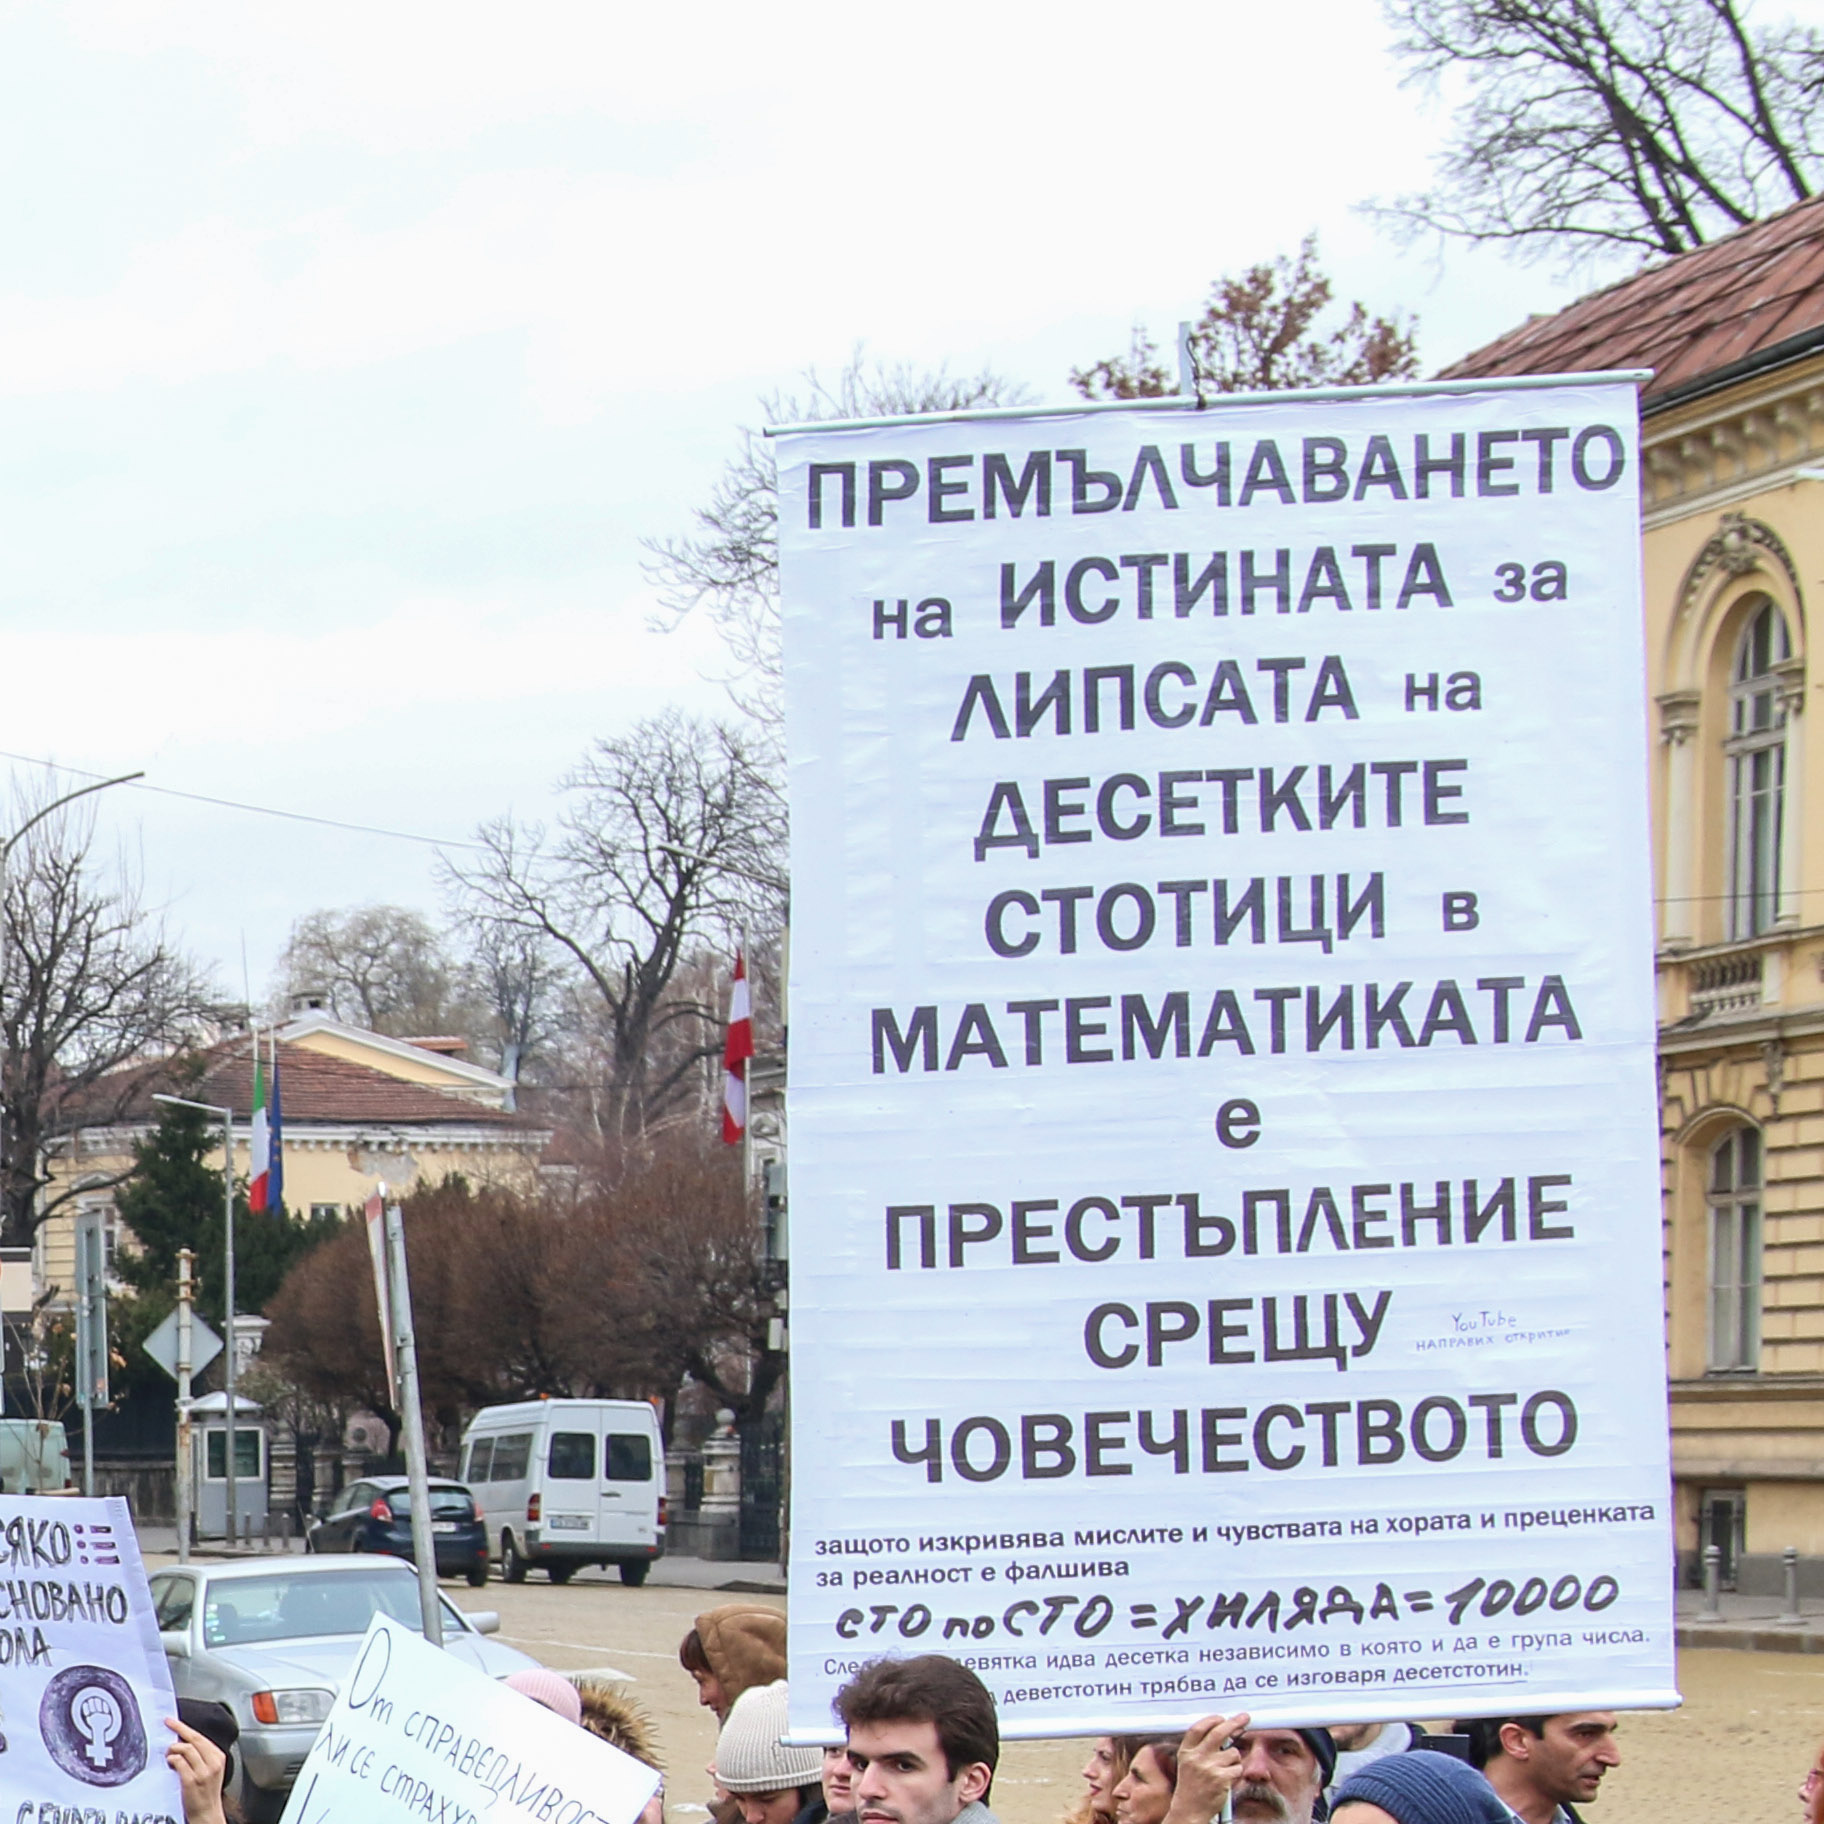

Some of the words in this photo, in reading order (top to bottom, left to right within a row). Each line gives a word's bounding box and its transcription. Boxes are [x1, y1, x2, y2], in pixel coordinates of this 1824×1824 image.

[808, 425, 1625, 528] ПРЕМЪЛЧАВАНЕТО
[873, 598, 953, 640] на
[1000, 543, 1453, 628] ИСТИНАТА
[1493, 560, 1568, 603] за
[951, 655, 1358, 741] ЛИПСАТА
[1404, 670, 1482, 711] на
[974, 758, 1470, 861] ДЕСЕТКИТЕ
[984, 872, 1385, 957] СТОТИЦИ
[1442, 891, 1479, 932] в
[872, 975, 1583, 1075] МАТЕМАТИКАТА
[1216, 1098, 1261, 1148] е
[885, 1175, 1575, 1271] ПРЕСТЪПЛЕНИЕ
[1084, 1290, 1392, 1370] СРЕЩУ
[891, 1389, 1579, 1484] ЧОВЕЧЕСТВОТО
[815, 1537, 910, 1557] защото
[919, 1531, 1064, 1555] изкривява
[1074, 1525, 1183, 1546] мислите
[1193, 1526, 1208, 1543] и
[1217, 1518, 1342, 1546] чувствата
[1351, 1515, 1378, 1535] на
[1386, 1513, 1471, 1538] хората
[1481, 1510, 1495, 1529] и
[1504, 1504, 1655, 1531] преценката
[816, 1569, 843, 1587] за
[853, 1566, 973, 1590] реалност
[981, 1566, 996, 1582] е
[1005, 1558, 1130, 1585] фалшива
[1003, 1680, 1132, 1704] деветстотин
[1140, 1675, 1215, 1697] трябва
[1223, 1674, 1246, 1693] да
[1255, 1672, 1278, 1689] се
[1287, 1666, 1385, 1688] изговаря
[1393, 1660, 1528, 1682] десетстотин.
[1047, 1654, 1095, 1671] идва
[1105, 1648, 1188, 1669] десетка
[1199, 1642, 1330, 1663] независимо
[1341, 1641, 1352, 1658] в
[1361, 1636, 1422, 1656] която
[1432, 1635, 1444, 1653] и
[1453, 1634, 1479, 1653] да
[1488, 1632, 1501, 1650] е
[1511, 1629, 1572, 1652] група
[1582, 1627, 1651, 1646] числа.
[350, 1745, 376, 1780] СЕ
